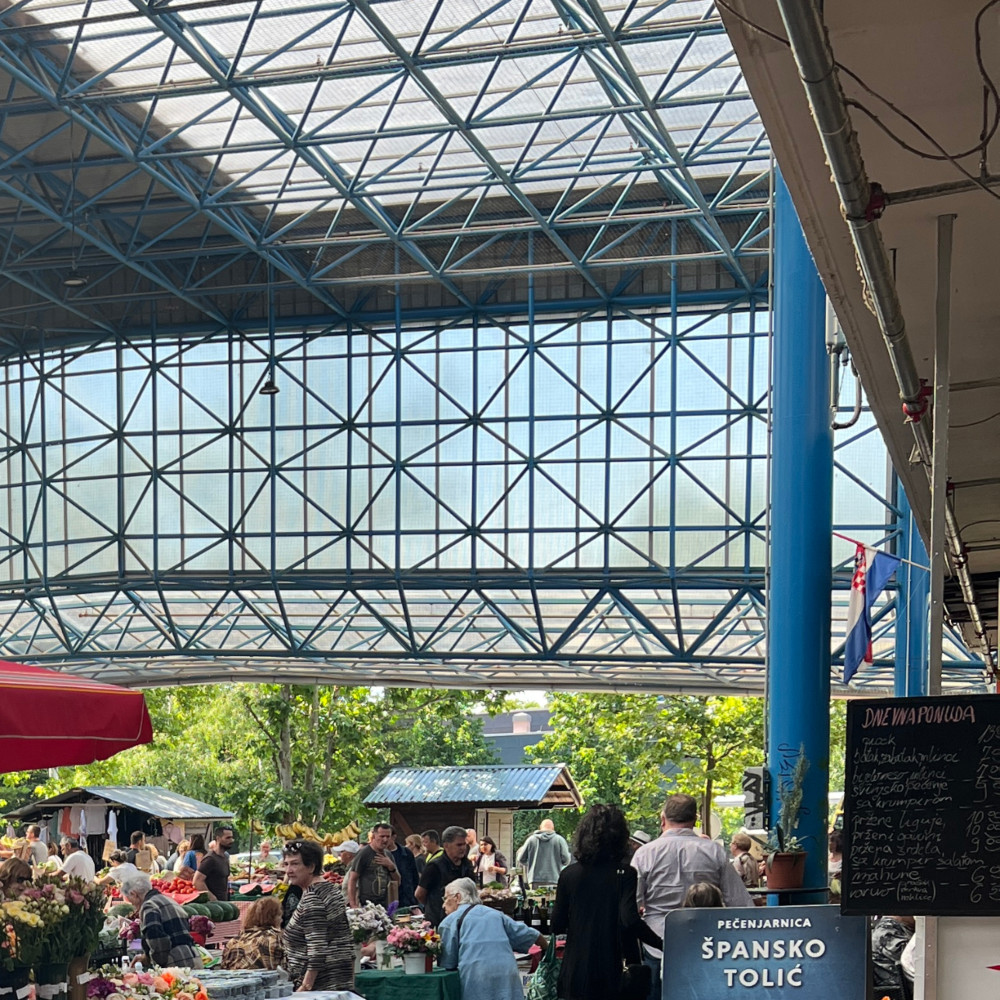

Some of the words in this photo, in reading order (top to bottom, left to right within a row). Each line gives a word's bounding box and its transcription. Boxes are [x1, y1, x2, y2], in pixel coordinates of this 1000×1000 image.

[915, 705, 976, 724] PONUDA
[717, 918, 812, 930] PEČENJARNICA
[701, 936, 826, 960] ŠPANSKO
[723, 963, 802, 987] TOLIĆ
